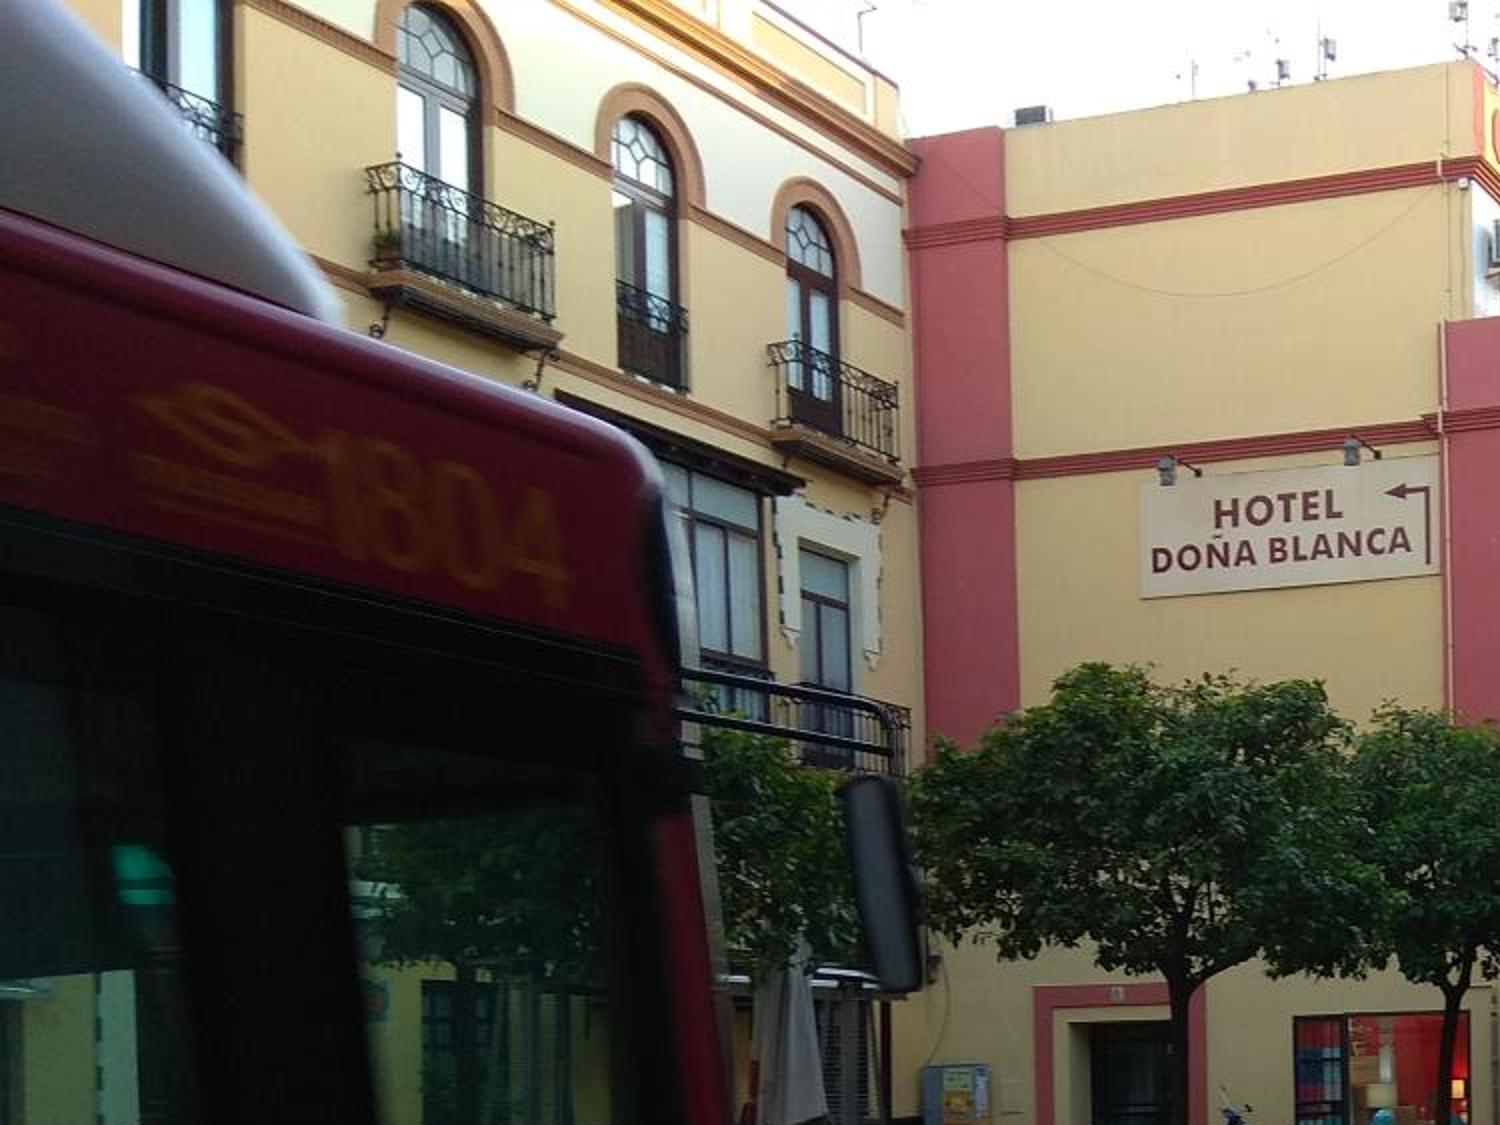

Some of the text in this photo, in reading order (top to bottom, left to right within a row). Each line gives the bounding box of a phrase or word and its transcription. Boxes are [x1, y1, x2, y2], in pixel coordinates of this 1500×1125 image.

[1214, 489, 1343, 529] HOTEL
[1151, 526, 1412, 573] DOÑA BLANCA
